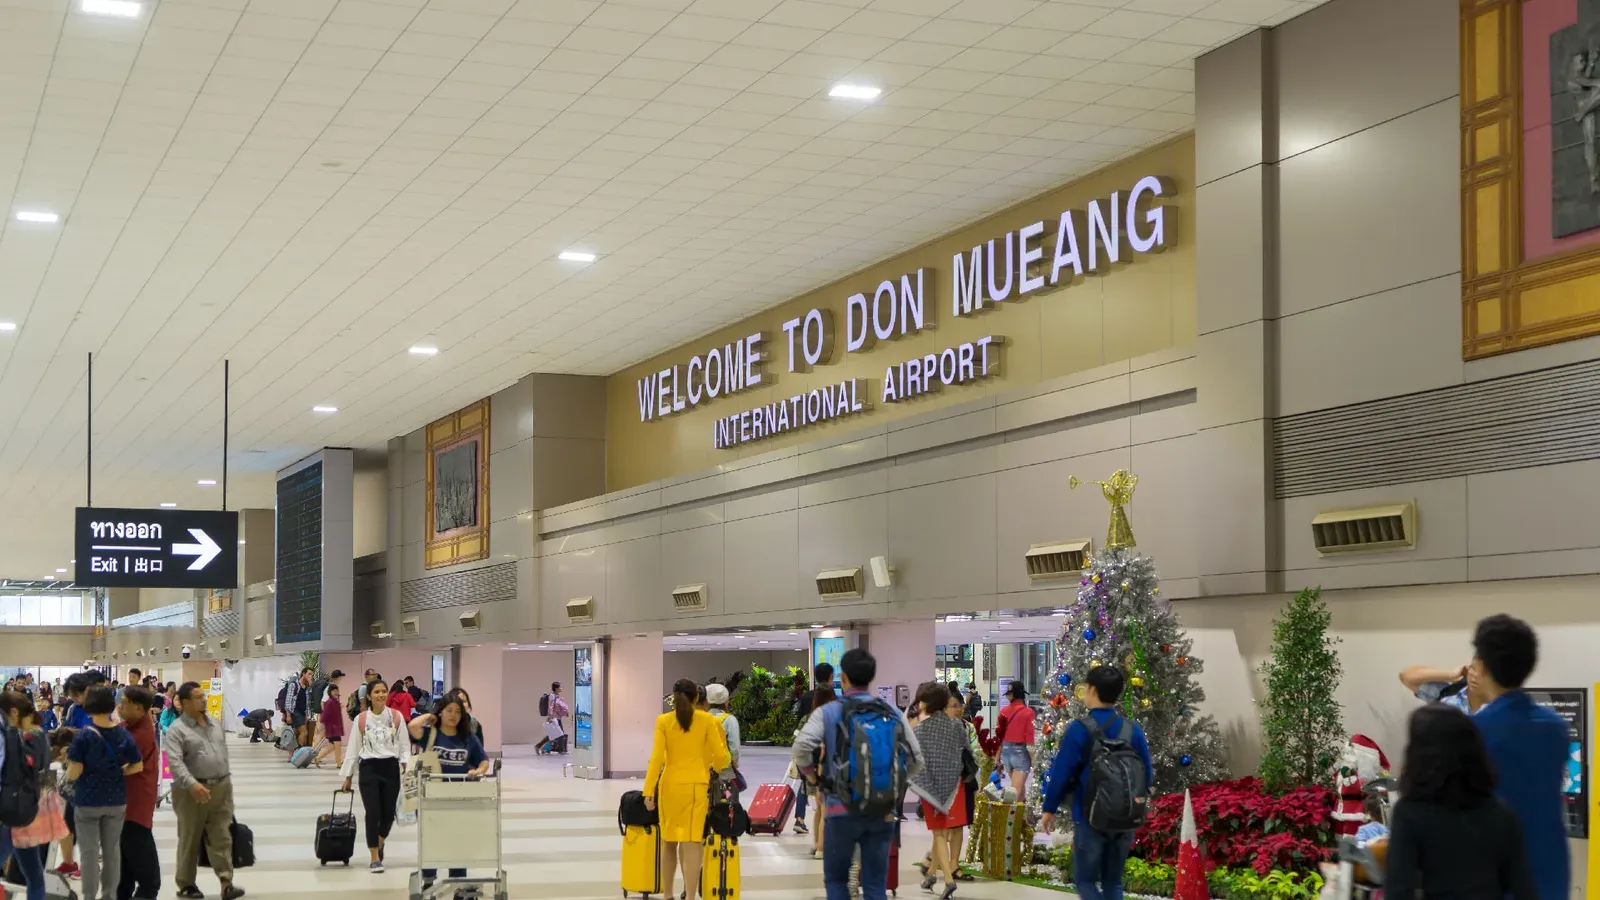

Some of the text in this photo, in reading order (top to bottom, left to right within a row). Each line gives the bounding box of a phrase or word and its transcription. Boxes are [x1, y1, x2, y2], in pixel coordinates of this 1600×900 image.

[637, 175, 1164, 422] WELCOME TO DON MUEANG
[713, 336, 992, 449] INTERNATIONAL AIRPORT
[90, 521, 162, 539] ทางออก
[91, 556, 118, 572] Exit
[134, 557, 163, 573] 出口
